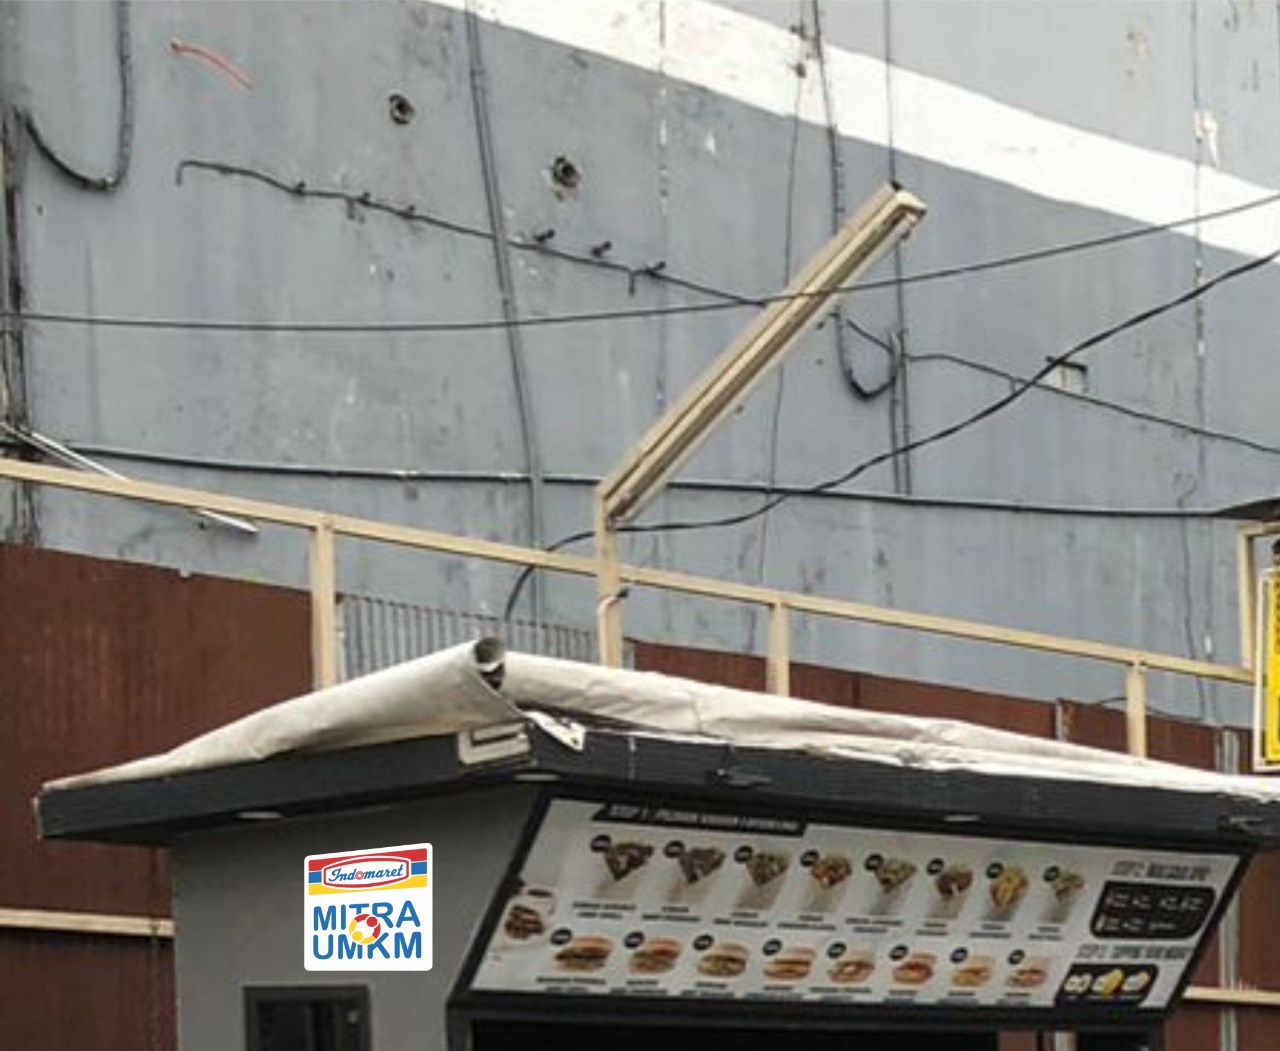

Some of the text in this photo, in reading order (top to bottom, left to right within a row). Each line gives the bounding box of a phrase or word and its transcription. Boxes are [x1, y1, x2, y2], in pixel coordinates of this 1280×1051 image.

[328, 864, 403, 882] Indomaret
[313, 900, 421, 931] MITRA
[313, 931, 421, 960] UMKM
